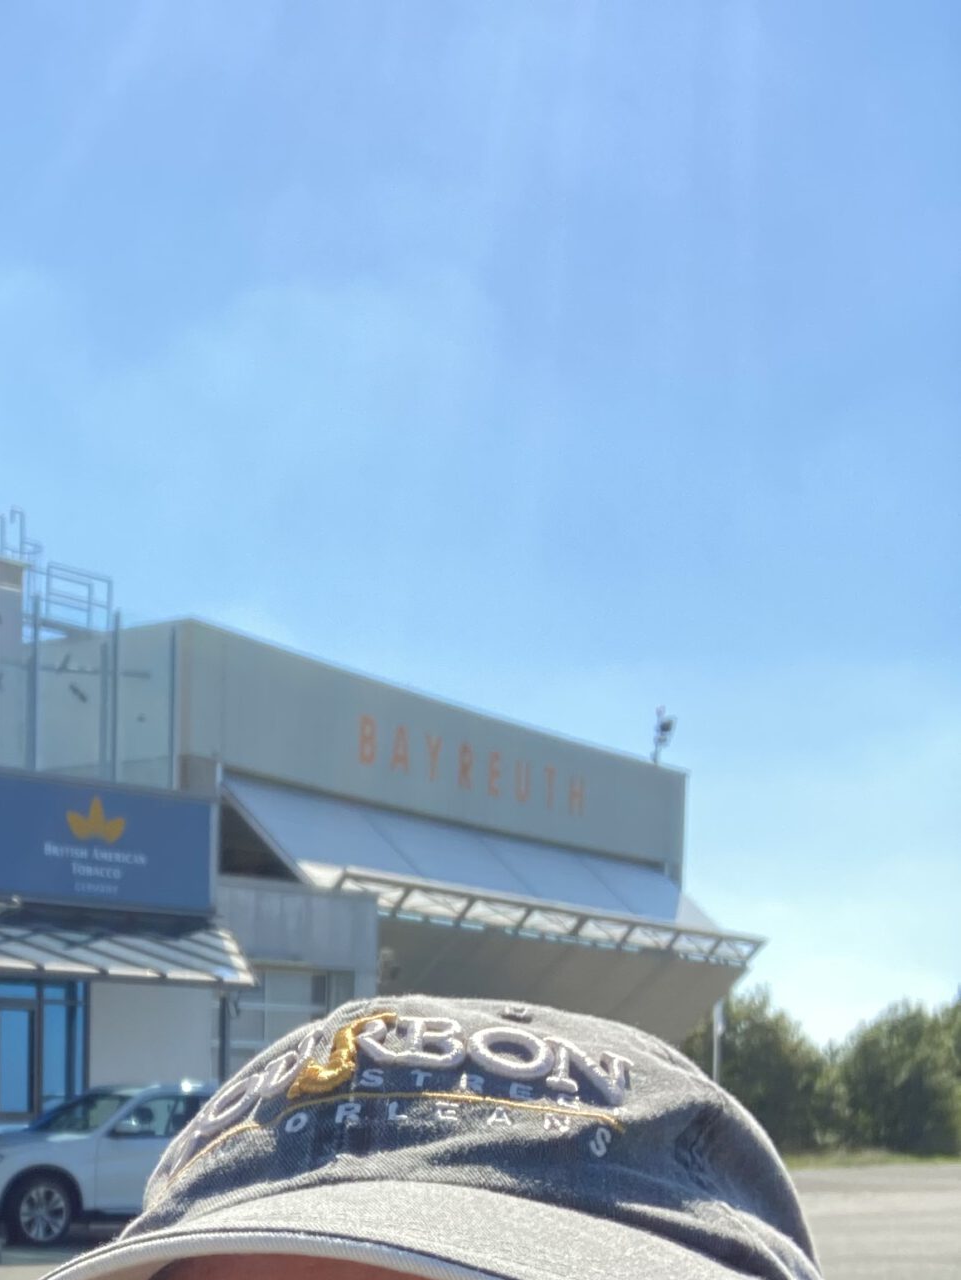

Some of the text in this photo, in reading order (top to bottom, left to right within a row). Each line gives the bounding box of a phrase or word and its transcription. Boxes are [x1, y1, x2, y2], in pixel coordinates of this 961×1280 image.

[358, 714, 585, 817] BAYREUTH
[43, 842, 148, 867] BRITISH AMERICAN
[71, 861, 122, 880] TOBACCO
[359, 1067, 628, 1118] STREE
[284, 1102, 613, 1158] ORLEANS
